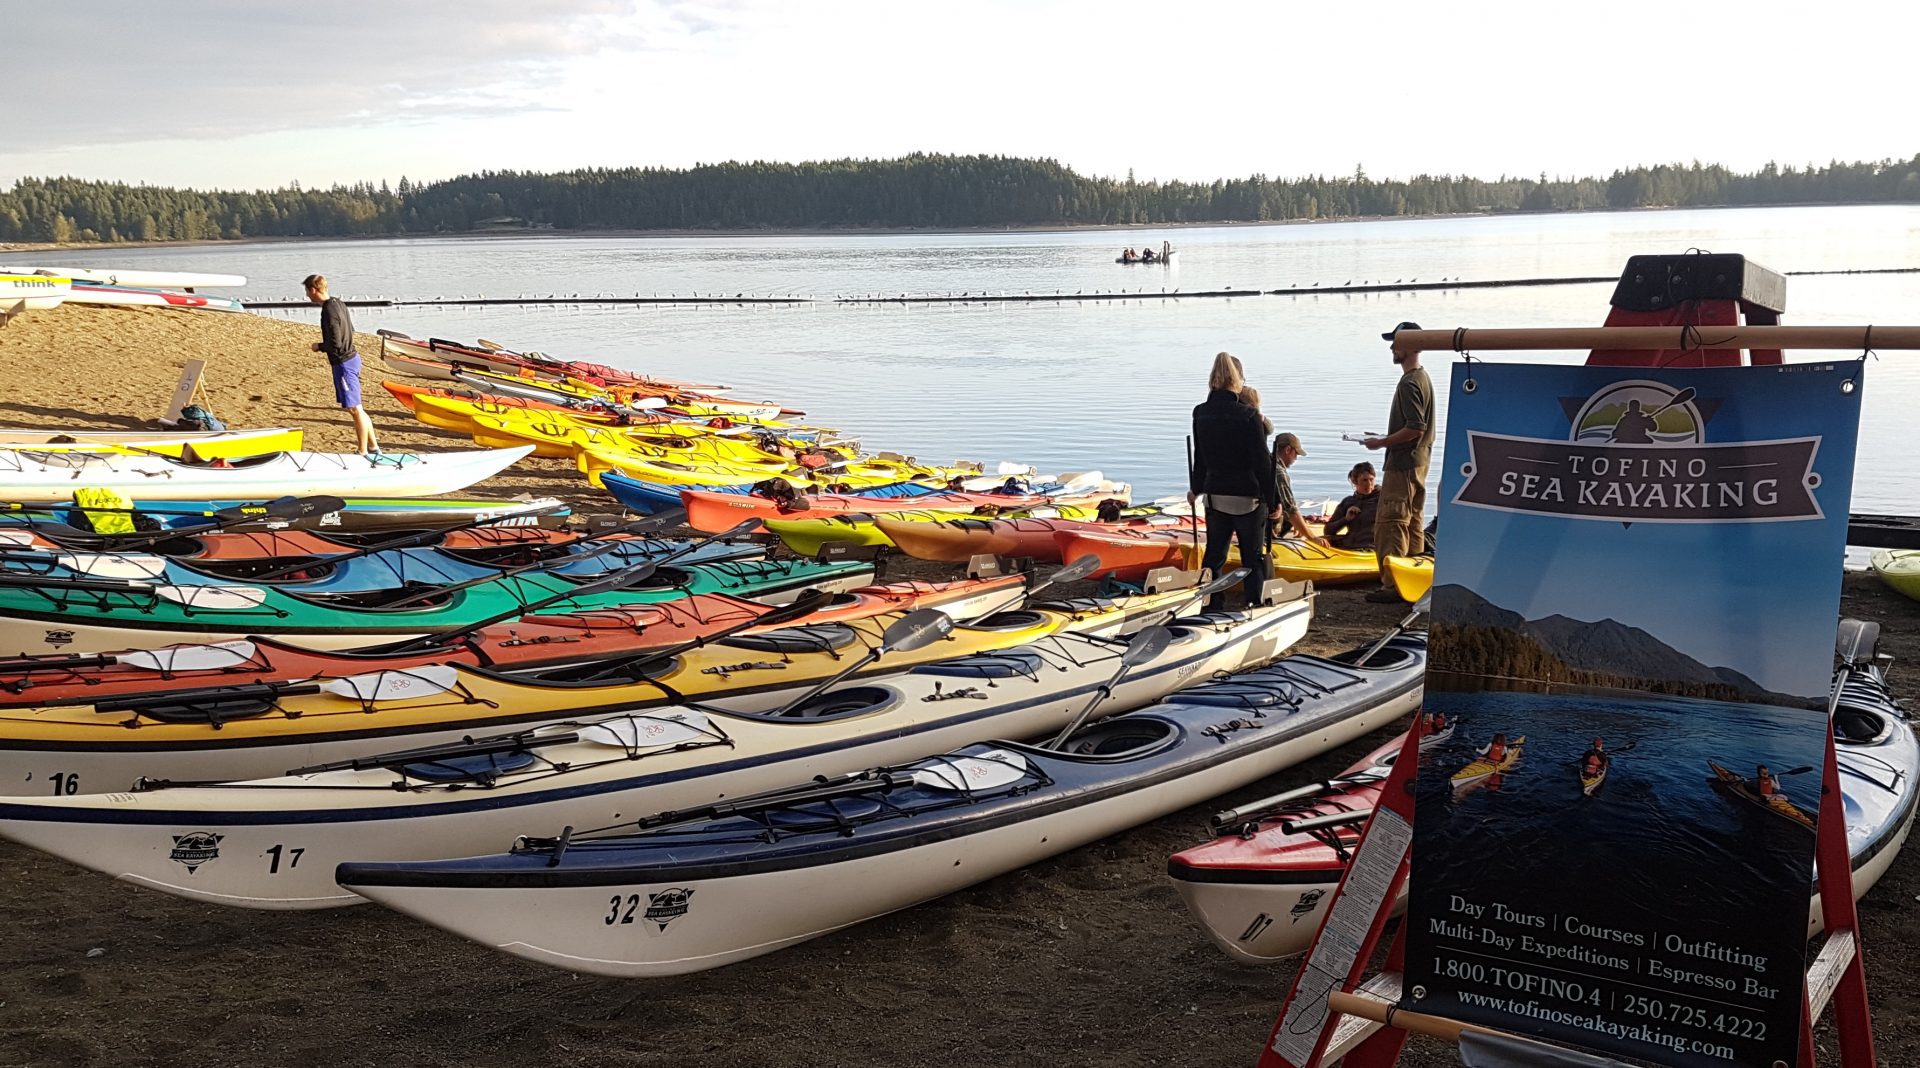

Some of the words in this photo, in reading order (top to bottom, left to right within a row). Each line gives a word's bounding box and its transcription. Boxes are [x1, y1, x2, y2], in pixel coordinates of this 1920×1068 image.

[13, 279, 56, 288] think
[1568, 455, 1706, 478] TOFINO
[1499, 471, 1565, 503] SEA
[1578, 479, 1777, 509] KAYAKING
[240, 507, 267, 515] think
[48, 772, 80, 797] 16
[266, 844, 306, 874] 17
[605, 893, 640, 926] 32
[1449, 894, 1486, 920] Day
[1491, 902, 1546, 928] Tours
[1564, 916, 1645, 946] Courses
[1664, 934, 1768, 972] Outfitting
[1429, 917, 1515, 951] Multi-Day
[1520, 935, 1630, 970] Expeditions
[1647, 959, 1736, 991] Espresso
[1743, 977, 1780, 1000] Bar
[1433, 957, 1601, 1007] 1.800.TOFINO.4
[1623, 994, 1767, 1042] 250.725.4222
[1457, 990, 1735, 1061] www.tofinoseakayaking.com
